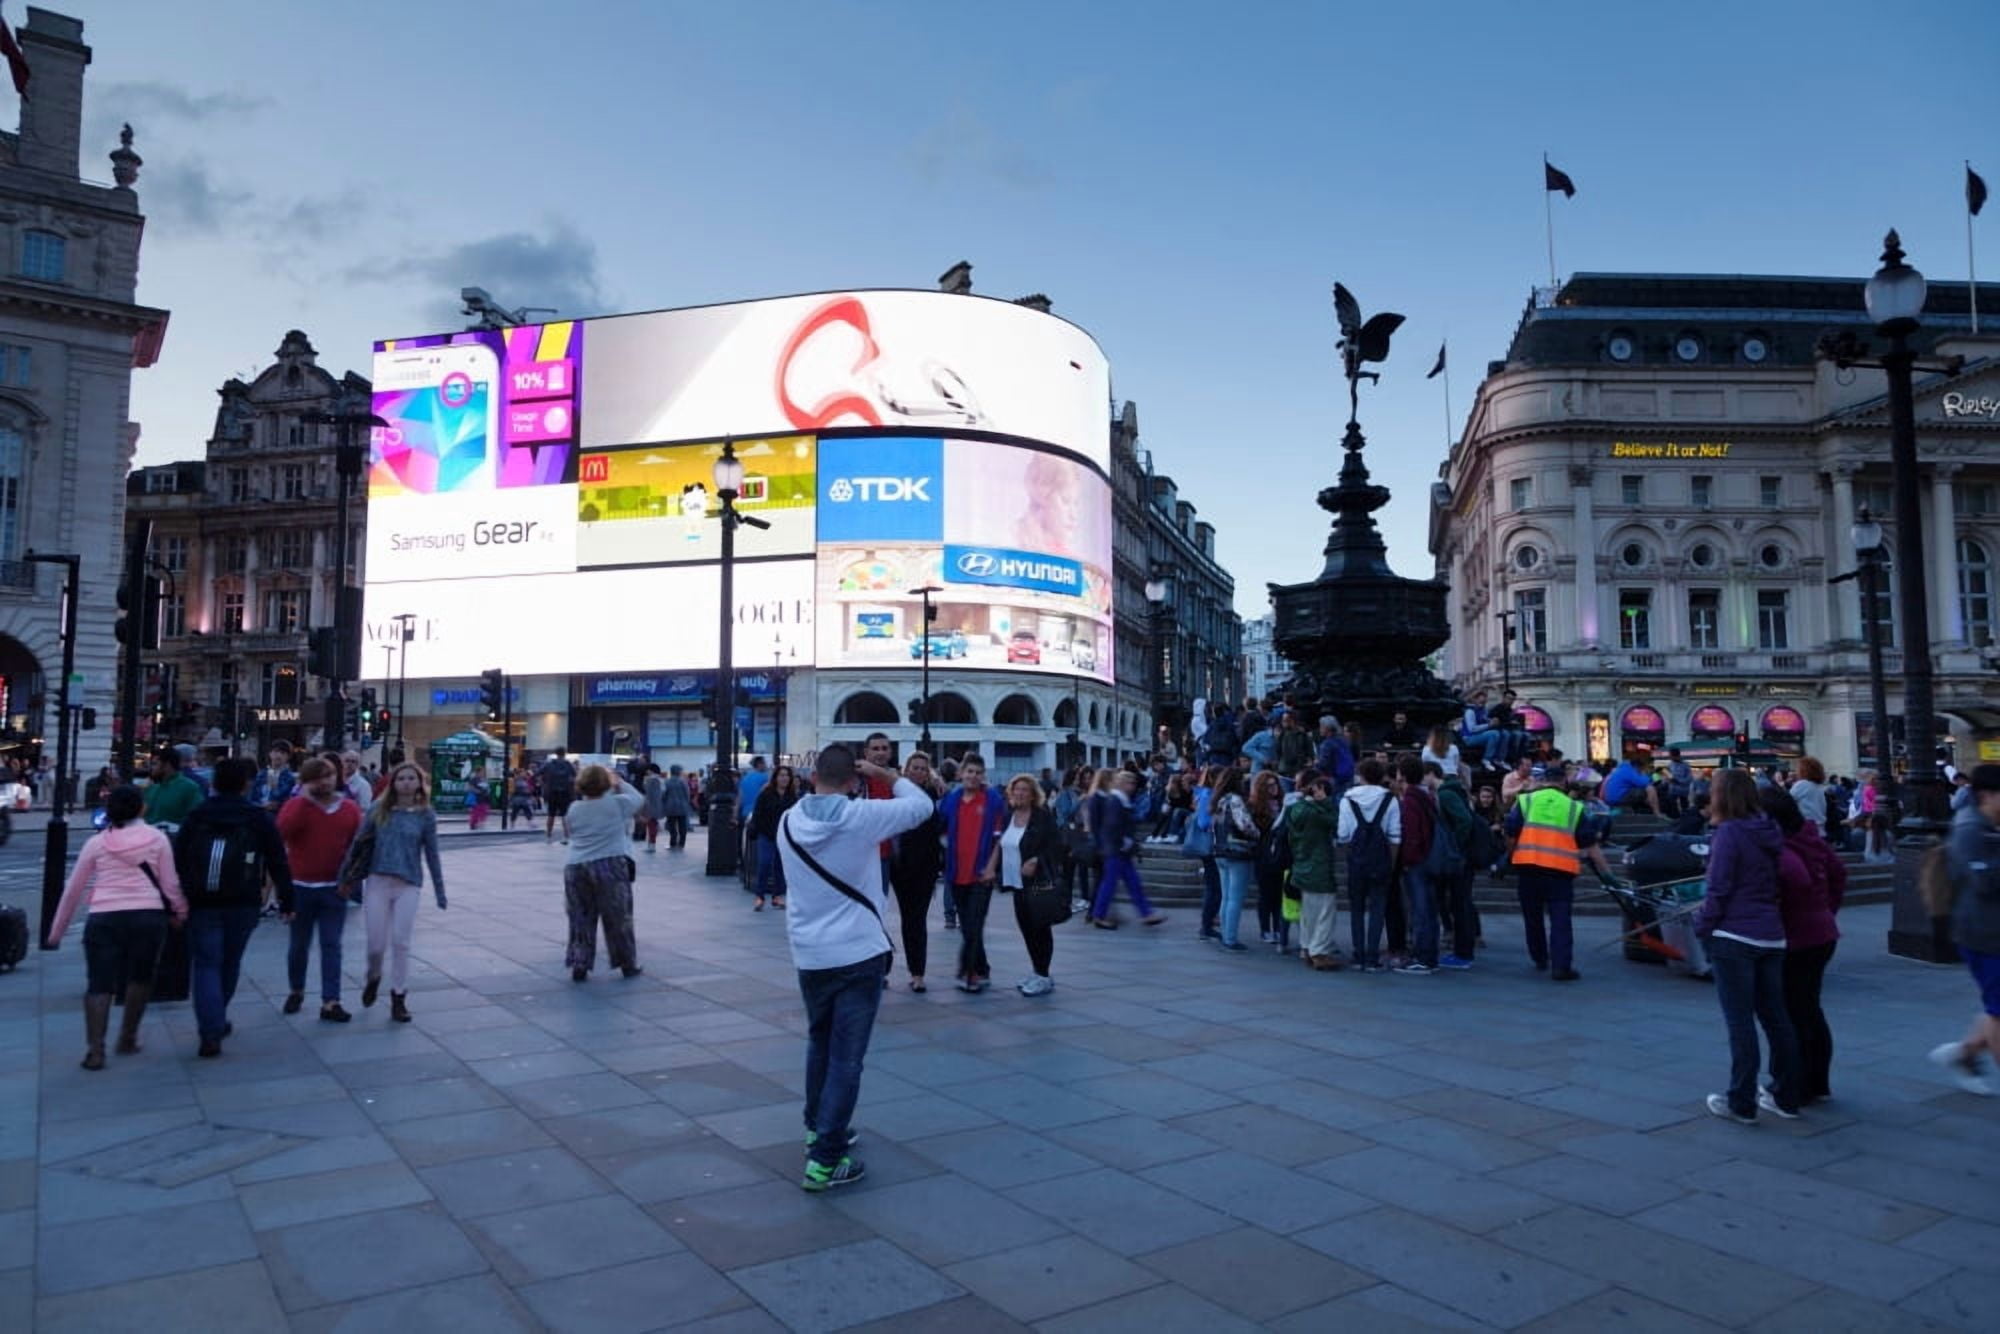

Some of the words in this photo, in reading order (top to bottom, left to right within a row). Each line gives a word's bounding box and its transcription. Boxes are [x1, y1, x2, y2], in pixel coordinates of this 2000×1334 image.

[513, 373, 545, 390] 10%
[1612, 442, 1662, 457] Believe
[852, 476, 931, 501] TDK
[390, 533, 466, 551] Samsung
[474, 520, 538, 546] Gear
[1002, 560, 1076, 584] HYUNDAI
[596, 678, 658, 694] pharmacy
